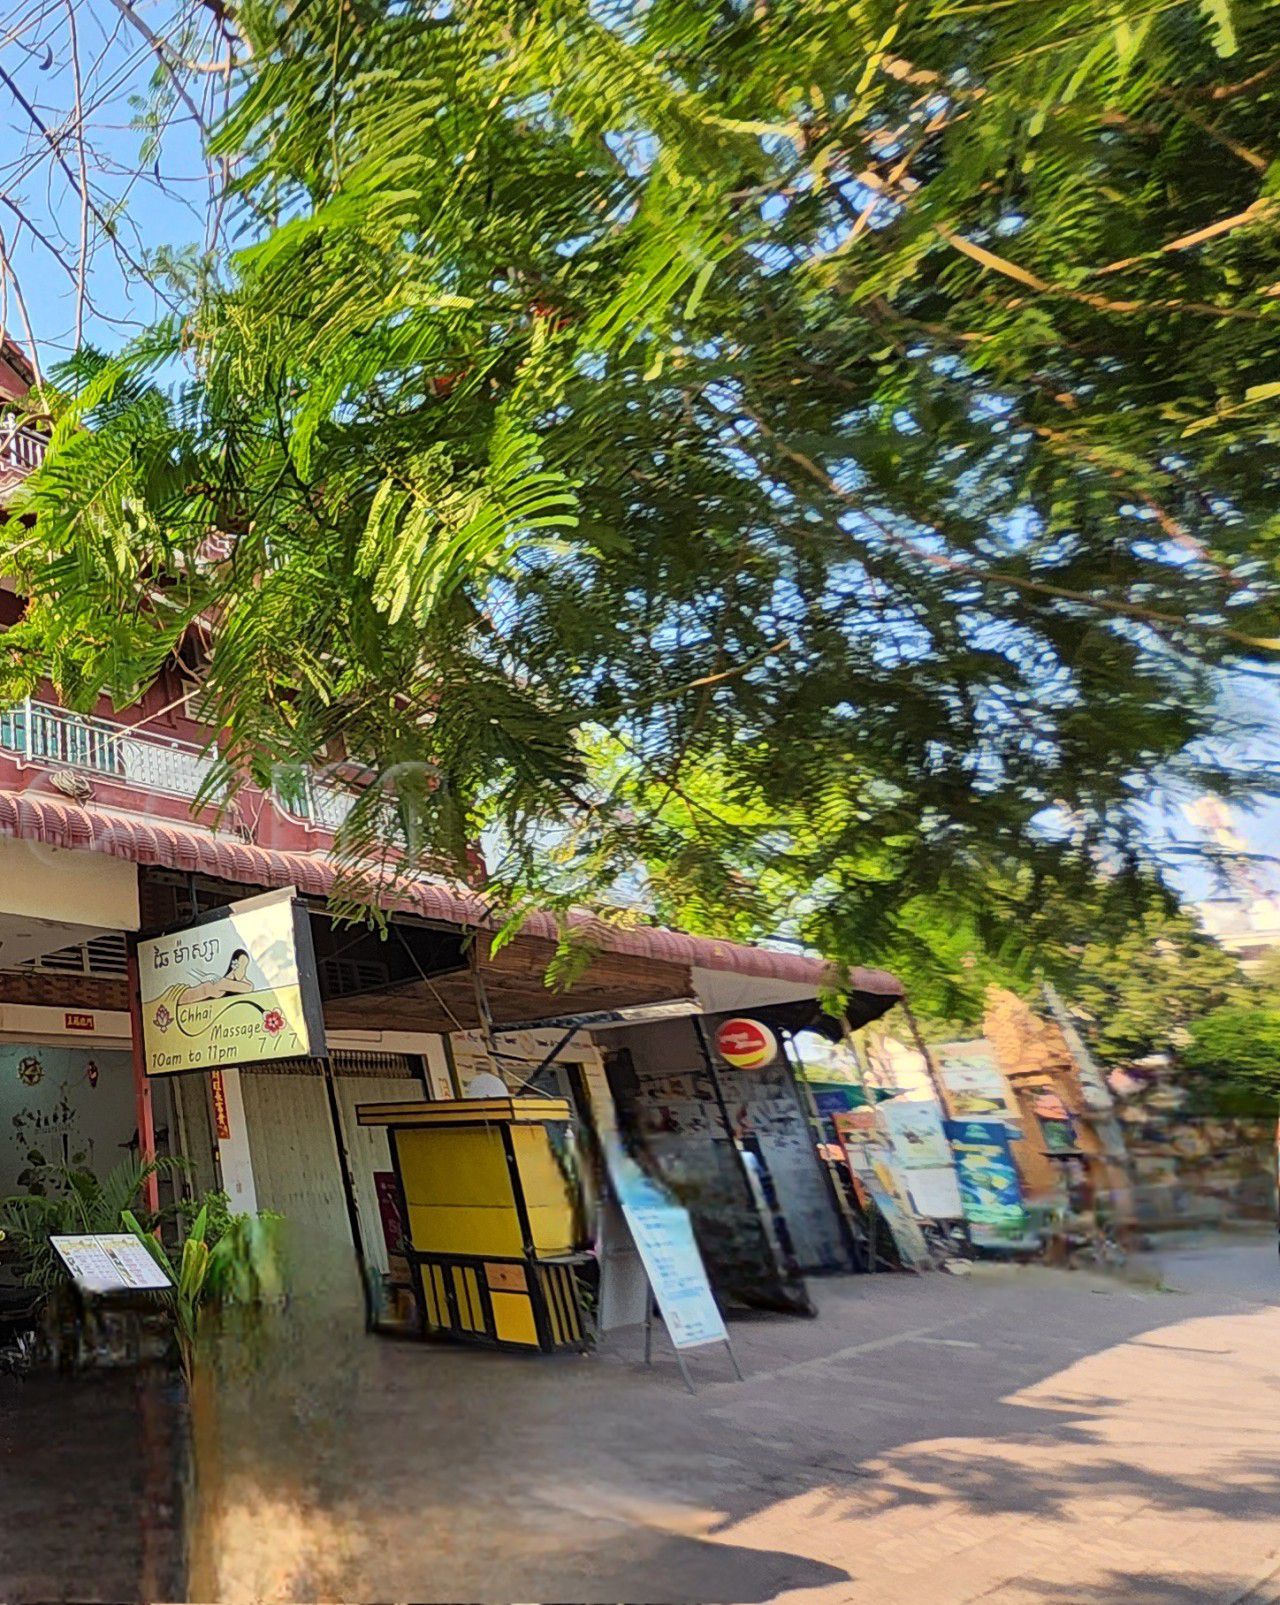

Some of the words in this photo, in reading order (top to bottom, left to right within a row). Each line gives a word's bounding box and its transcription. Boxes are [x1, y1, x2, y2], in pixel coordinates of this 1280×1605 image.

[179, 1005, 214, 1024] Chhai
[210, 1022, 261, 1041] Massage
[152, 1051, 182, 1068] 10am
[188, 1050, 202, 1063] to
[207, 1044, 238, 1063] 11pm
